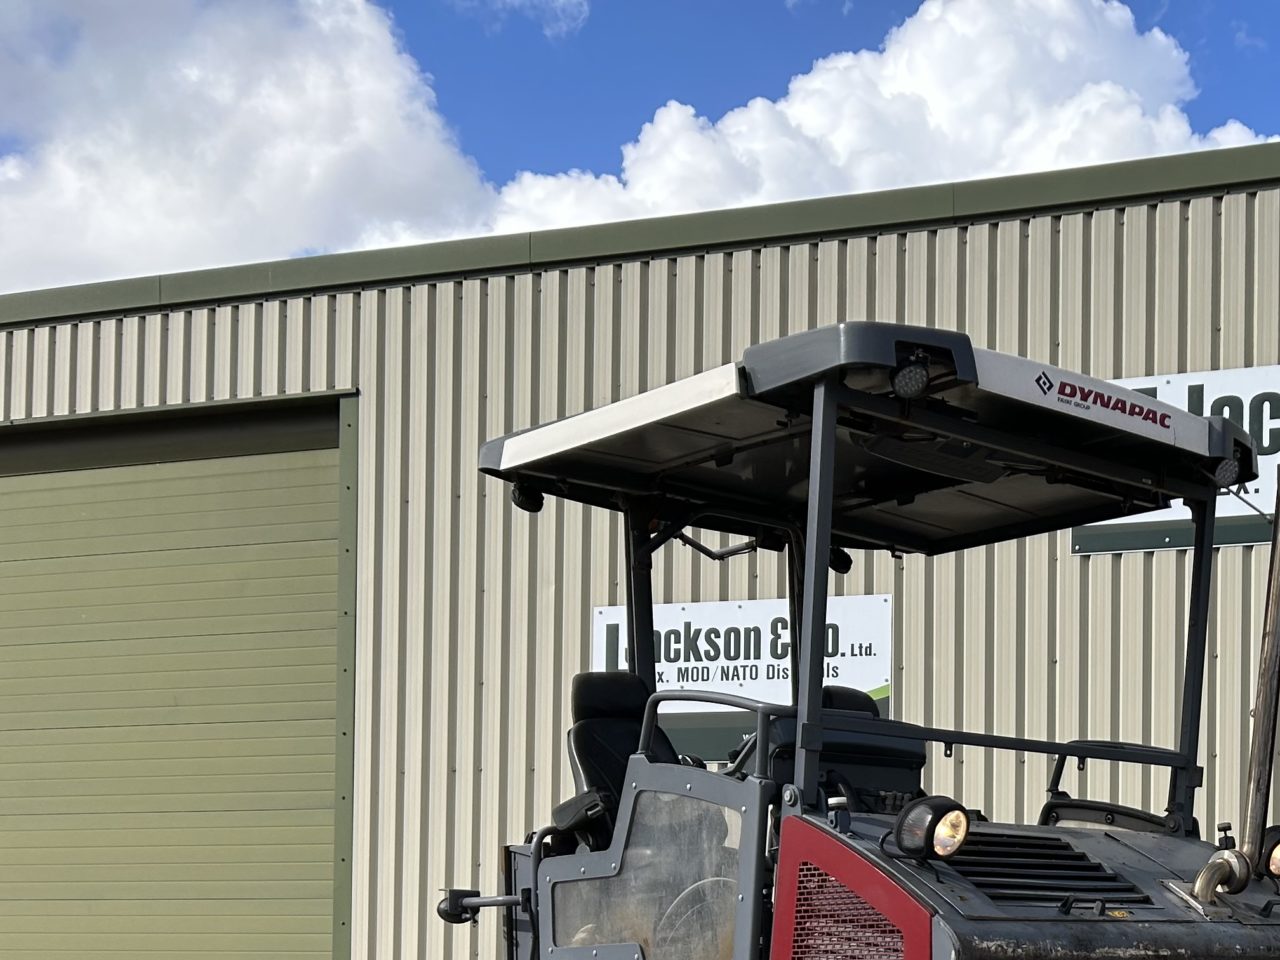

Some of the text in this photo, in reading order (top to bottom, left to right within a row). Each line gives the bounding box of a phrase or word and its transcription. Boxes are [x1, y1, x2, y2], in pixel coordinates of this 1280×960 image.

[1057, 380, 1172, 429] DYNAPAC
[770, 616, 792, 661] &
[824, 623, 846, 658] o.
[851, 642, 877, 657] Ltd.
[677, 664, 759, 683] MOD/NATO
[766, 662, 840, 680] Disls
